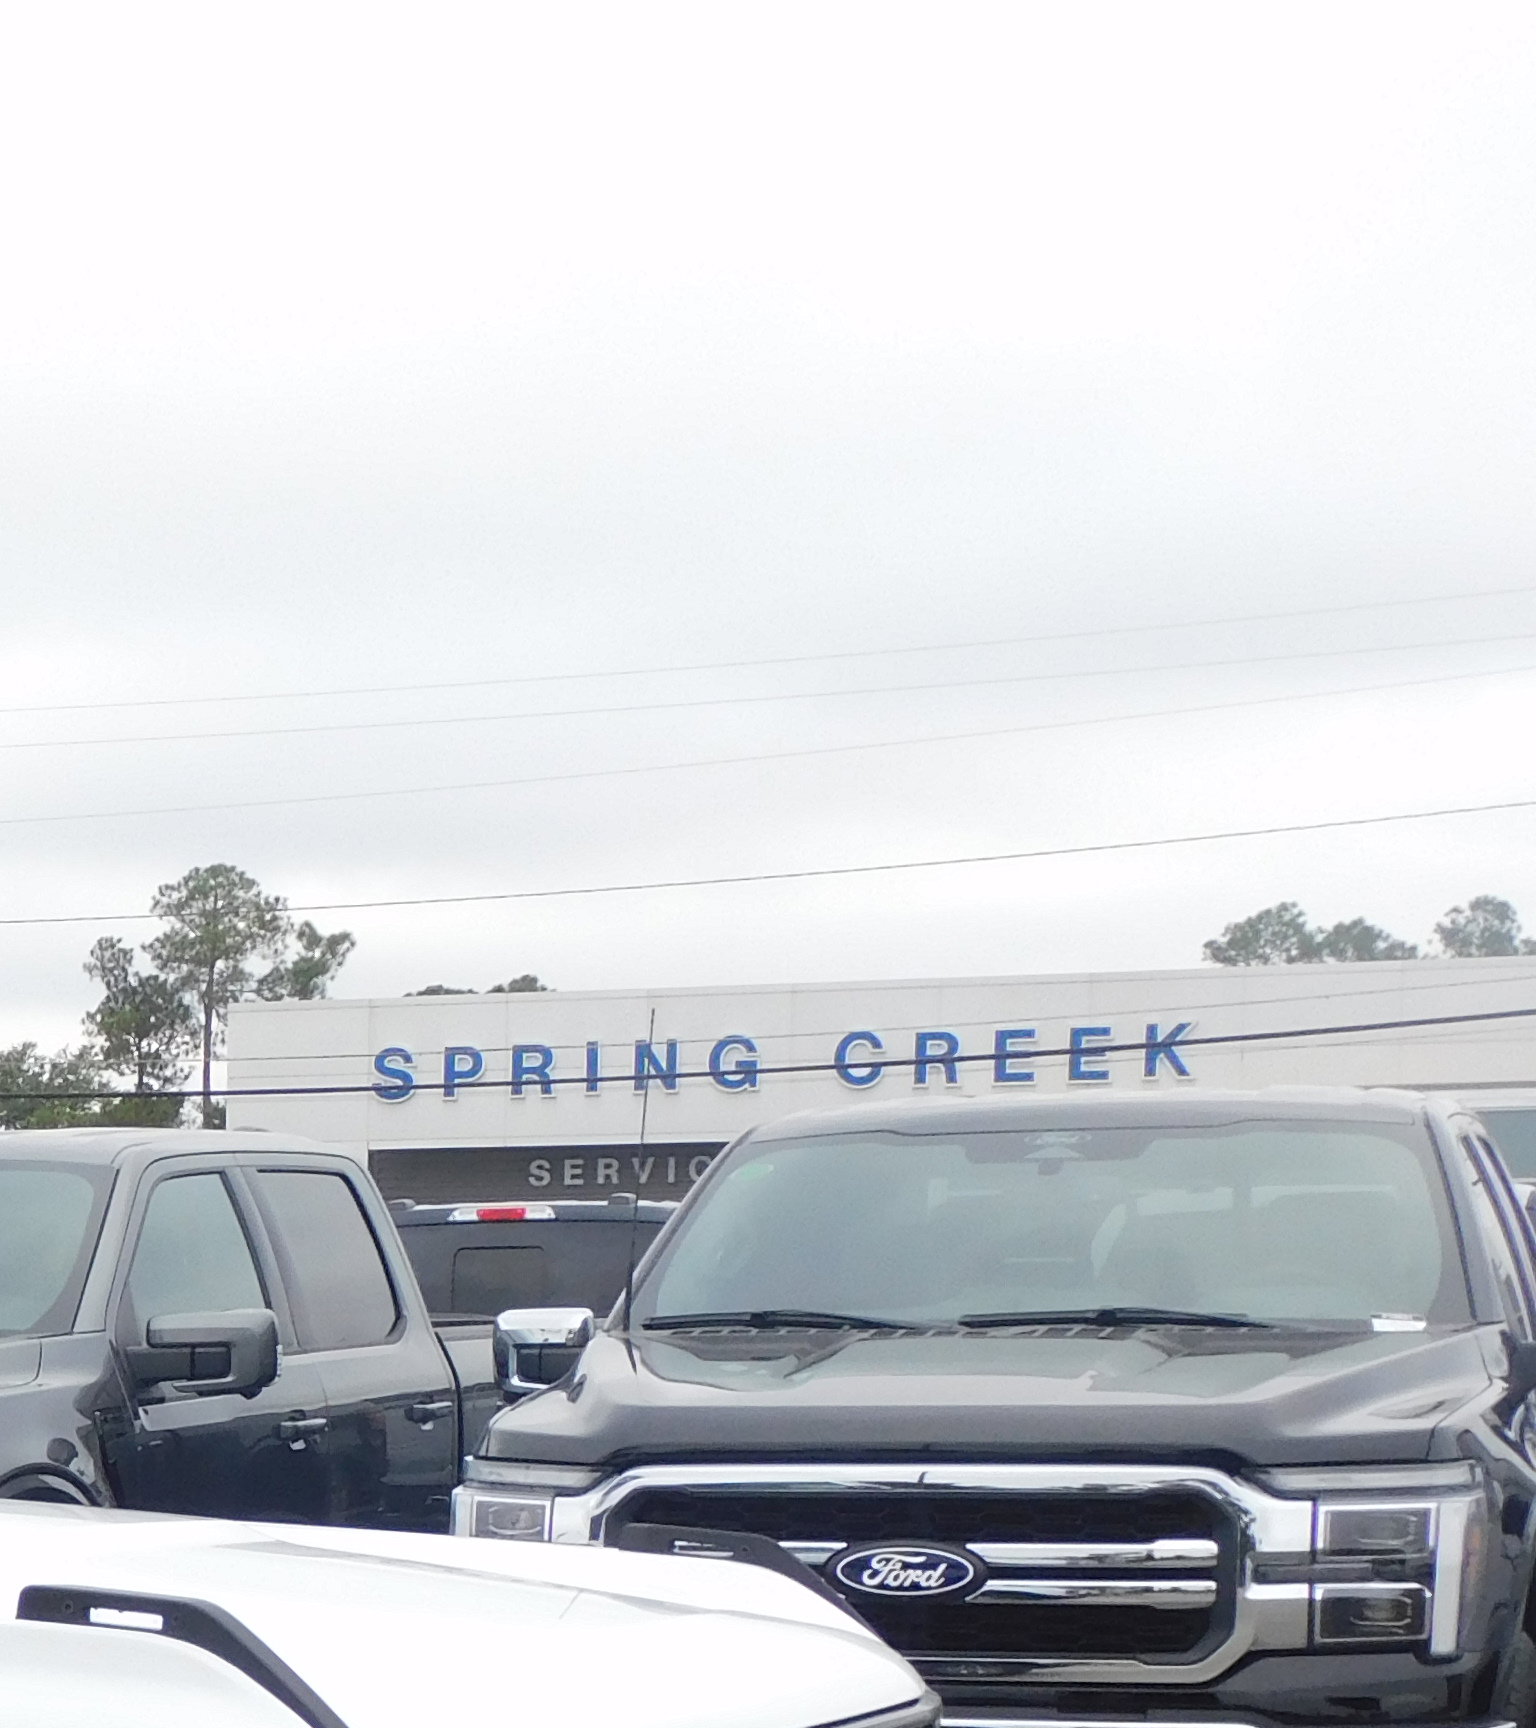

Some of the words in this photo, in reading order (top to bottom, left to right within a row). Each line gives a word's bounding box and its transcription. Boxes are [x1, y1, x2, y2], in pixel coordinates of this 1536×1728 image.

[372, 1034, 760, 1101] SPRING
[833, 1021, 1196, 1088] CREEK
[529, 1155, 713, 1187] SERVIC
[862, 1553, 948, 1588] Ford
